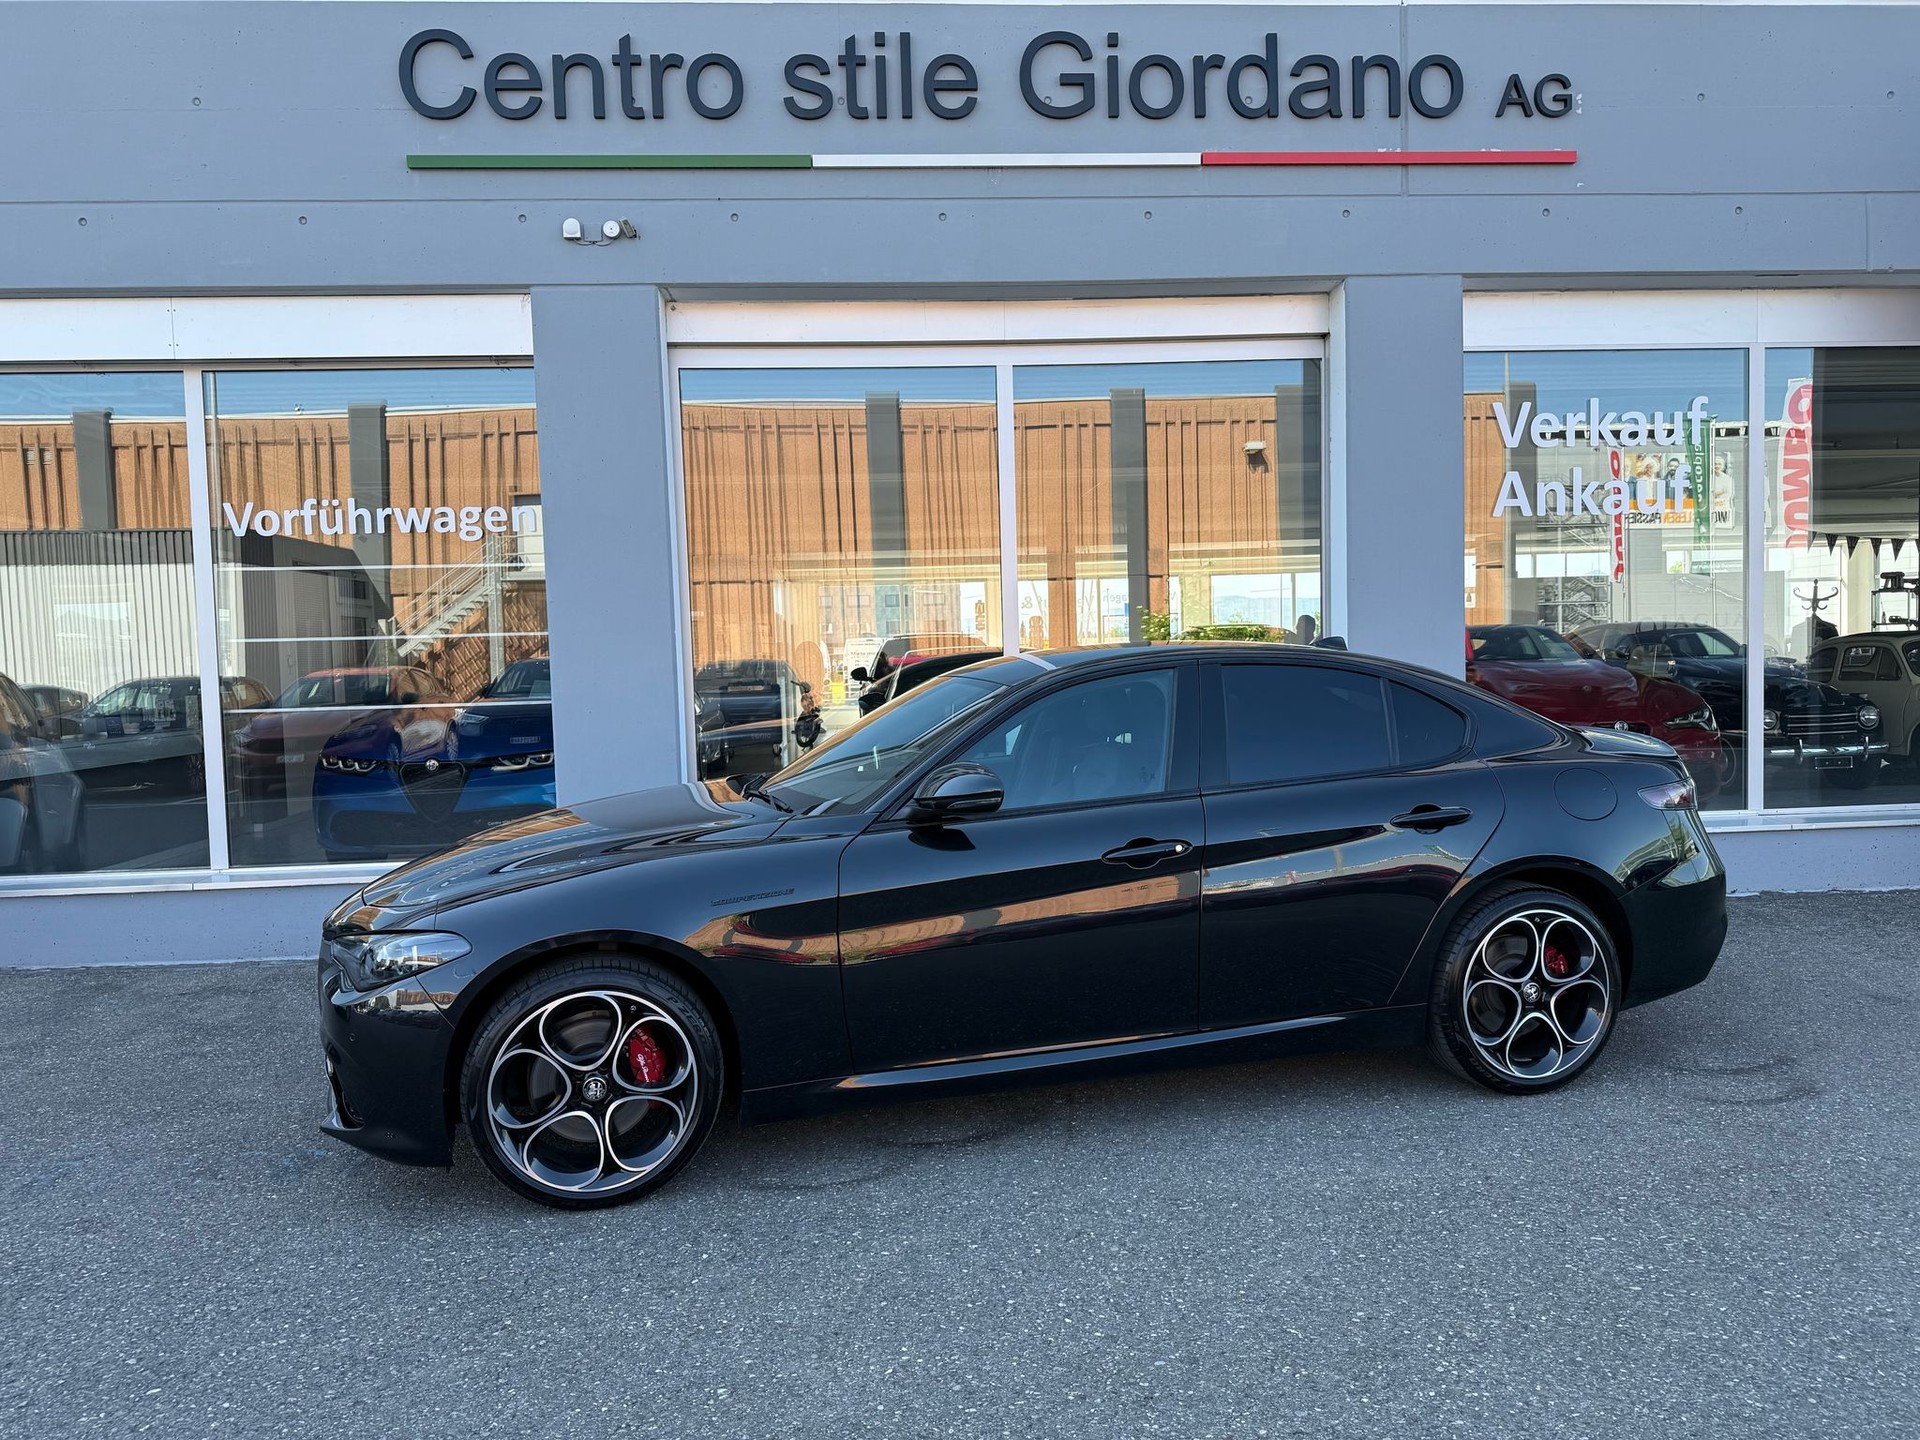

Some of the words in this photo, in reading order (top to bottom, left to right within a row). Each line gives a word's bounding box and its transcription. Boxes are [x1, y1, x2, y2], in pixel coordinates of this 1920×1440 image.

[398, 28, 743, 121] Centro
[783, 31, 979, 121] stile
[1018, 30, 1464, 119] Giordano
[1495, 72, 1573, 119] AG
[1492, 396, 1709, 449] Verkauf
[1492, 464, 1692, 517] Ankauf
[223, 498, 537, 541] Vorführwagen
